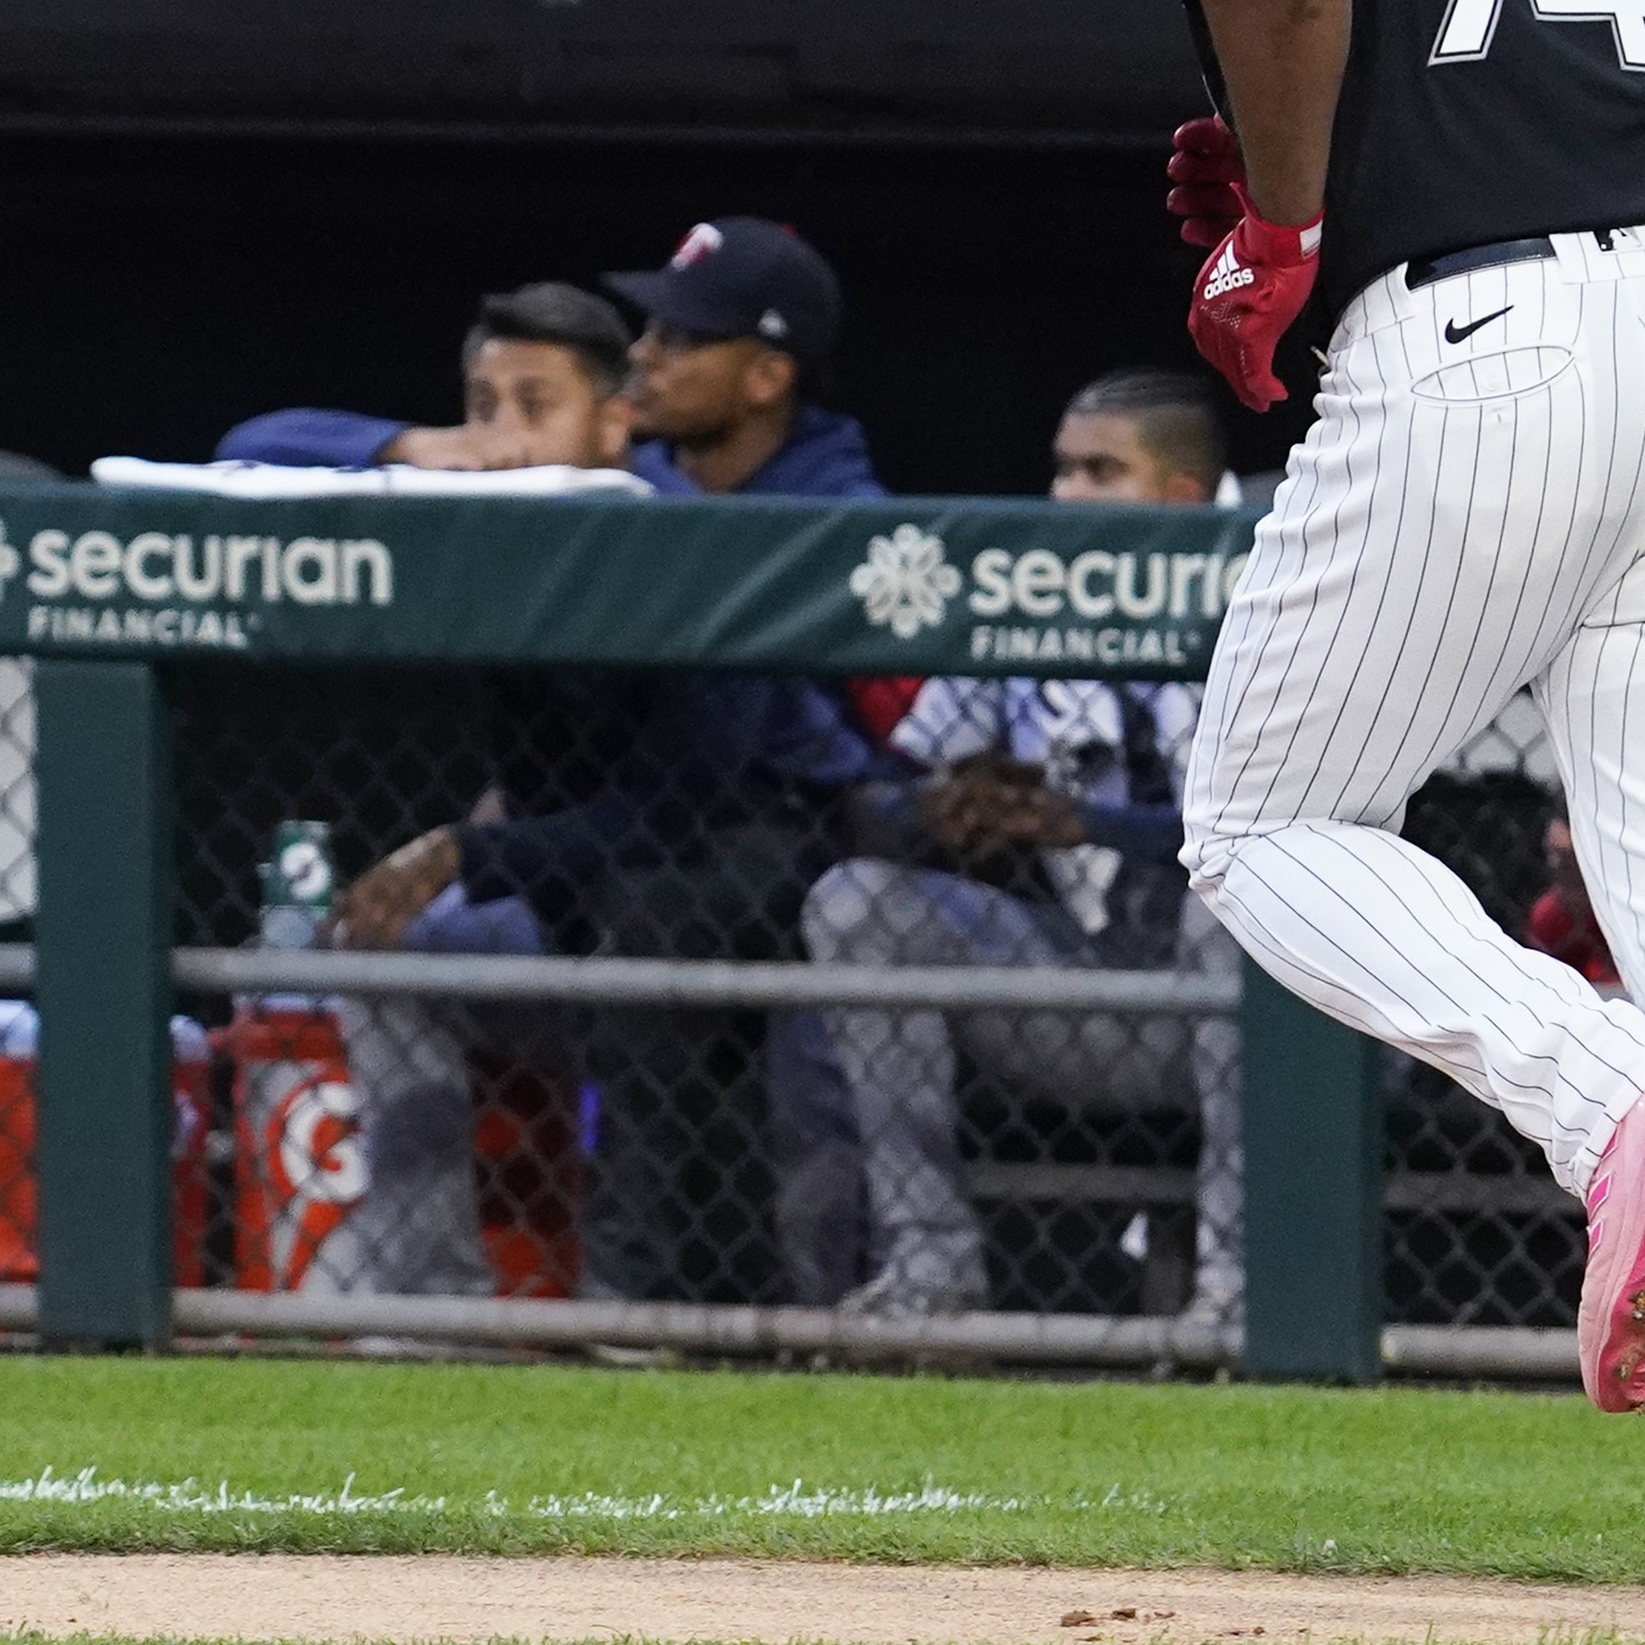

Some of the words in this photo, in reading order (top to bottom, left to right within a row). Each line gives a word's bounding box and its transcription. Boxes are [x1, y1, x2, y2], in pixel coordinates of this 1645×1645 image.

[1203, 266, 1255, 301] adidas
[26, 528, 394, 606] securian
[968, 547, 1250, 620] securi
[280, 1081, 373, 1203] G
